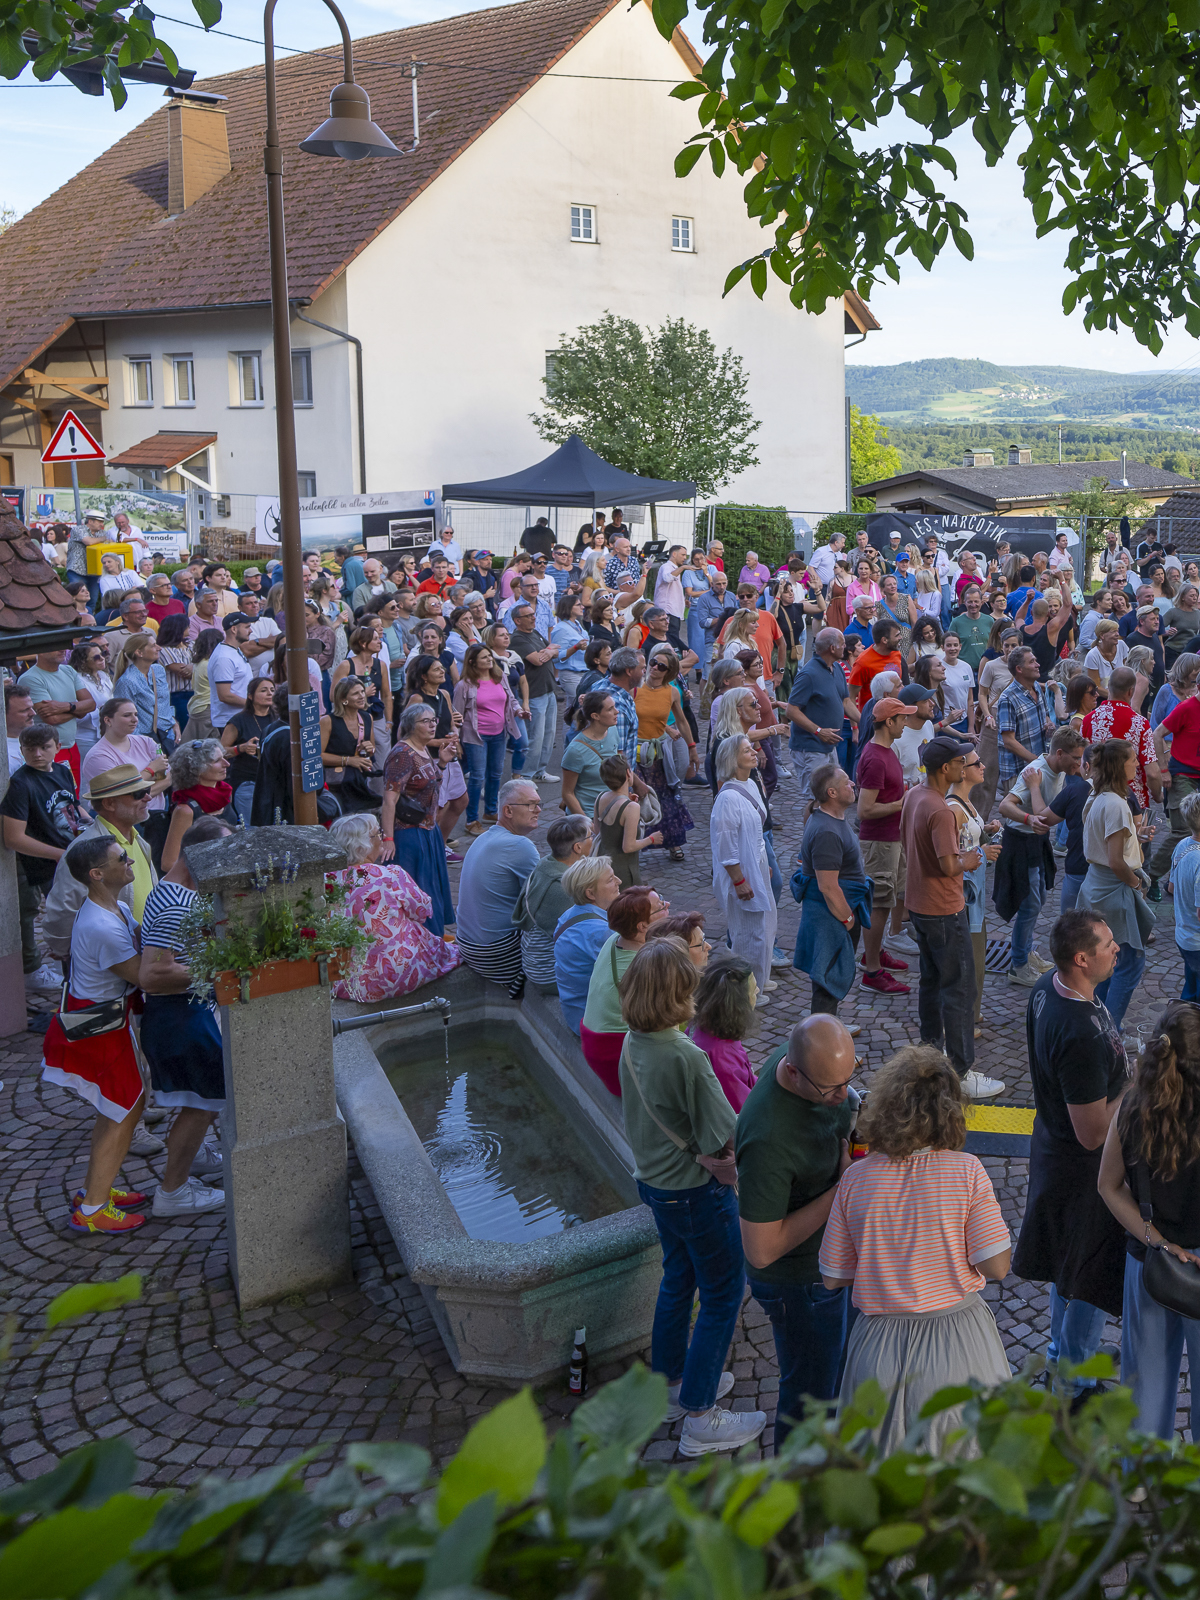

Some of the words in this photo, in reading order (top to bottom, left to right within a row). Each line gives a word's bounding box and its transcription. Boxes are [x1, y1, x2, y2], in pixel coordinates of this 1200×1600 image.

[299, 499, 338, 512] reitenfeld
[349, 498, 366, 507] alten
[910, 517, 932, 538] LES
[941, 515, 1008, 542] NARCOTIK
[301, 698, 307, 707] S
[302, 731, 308, 740] S
[304, 764, 310, 773] S
